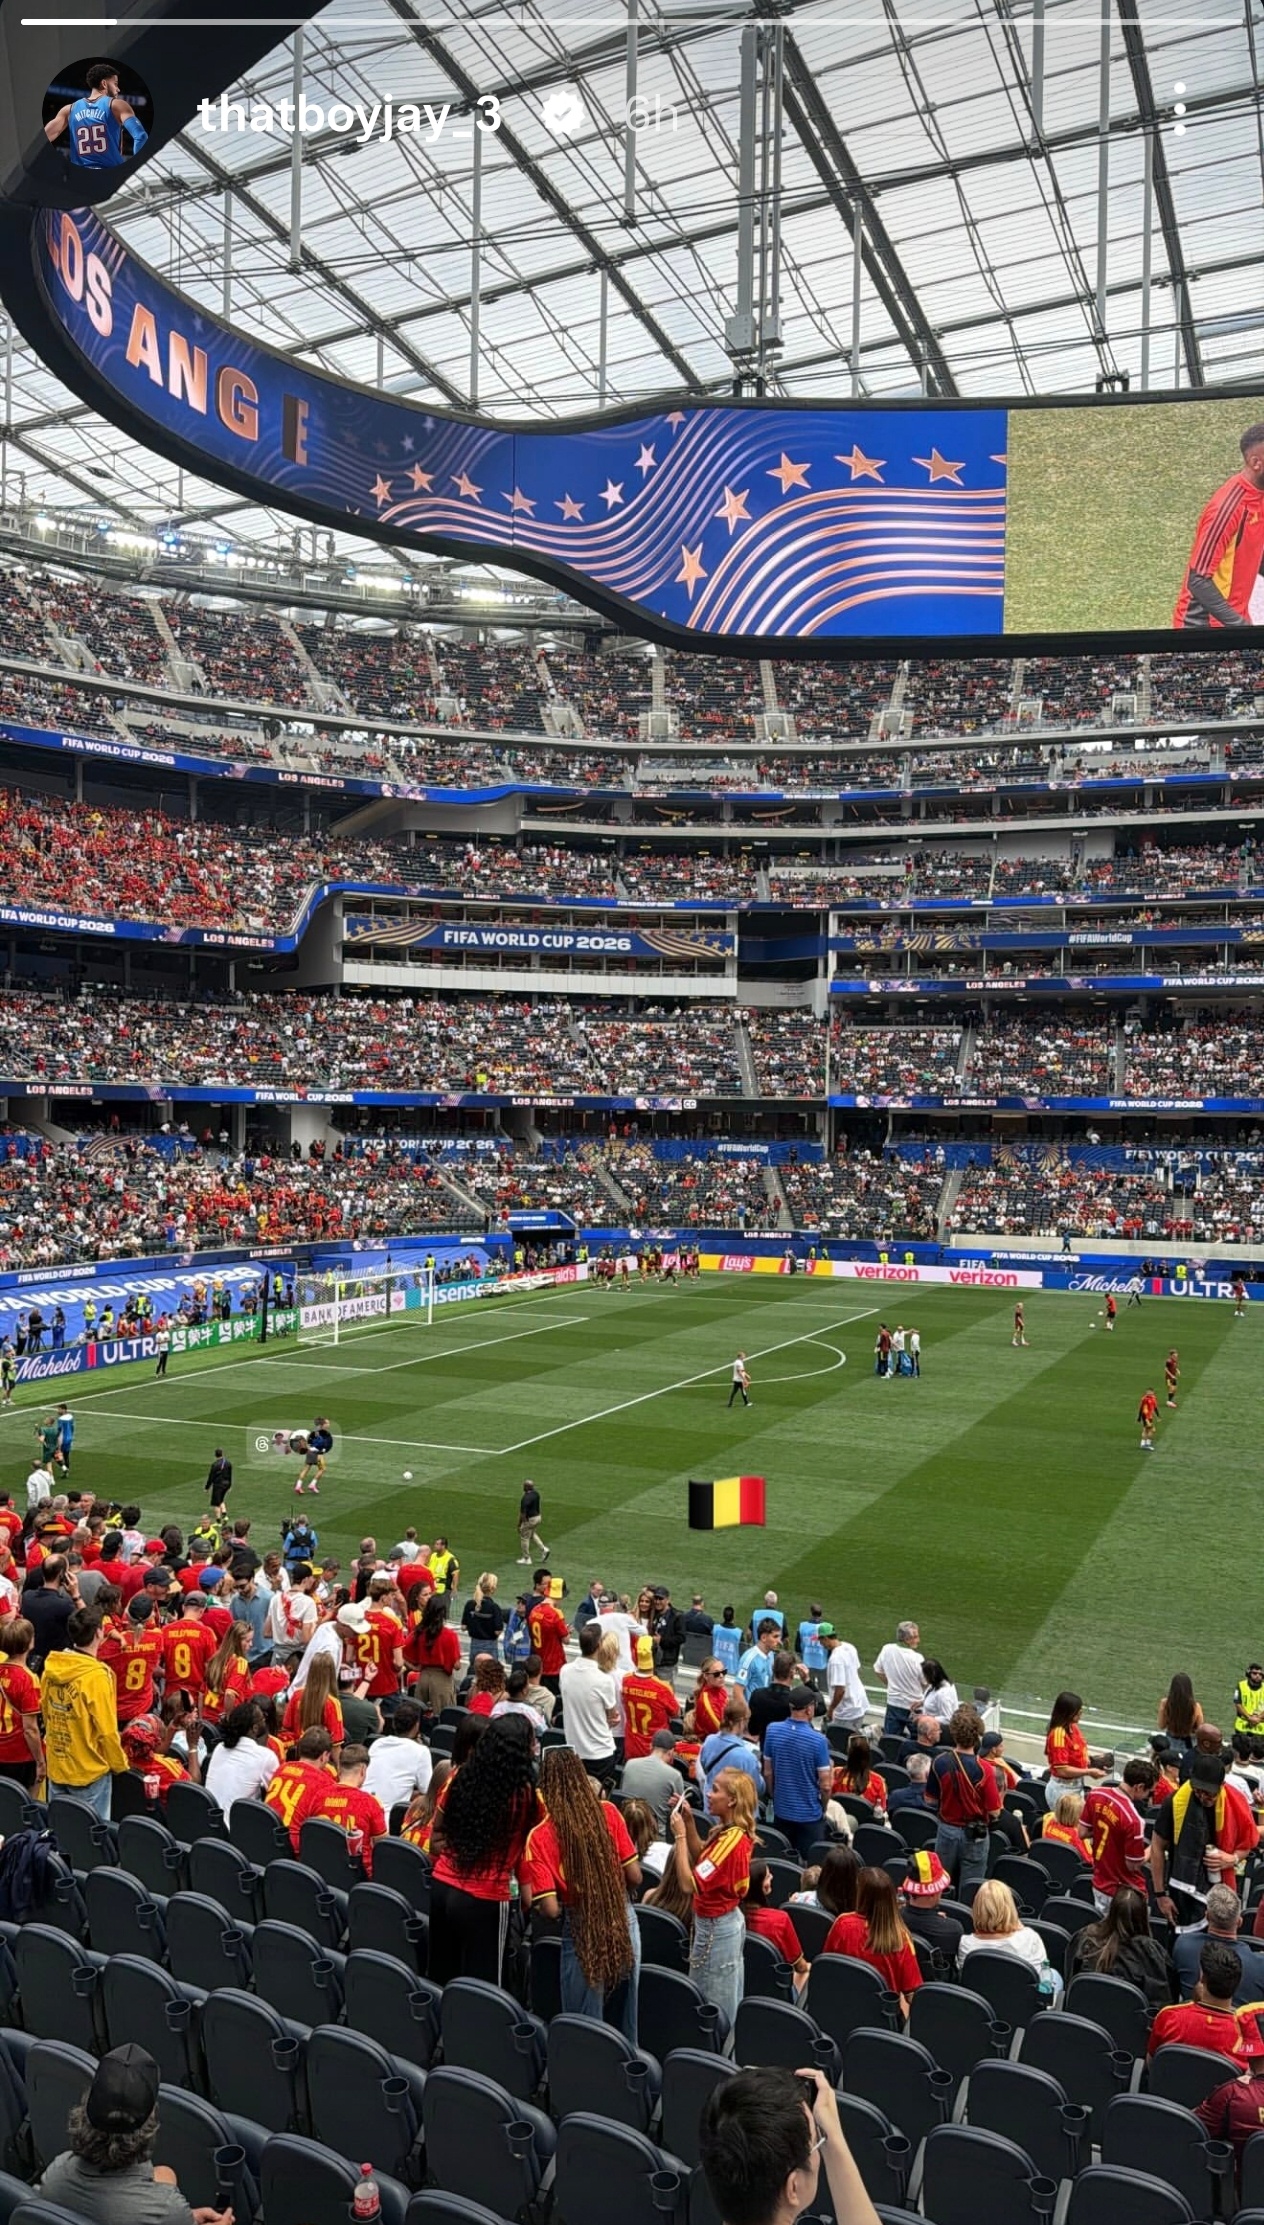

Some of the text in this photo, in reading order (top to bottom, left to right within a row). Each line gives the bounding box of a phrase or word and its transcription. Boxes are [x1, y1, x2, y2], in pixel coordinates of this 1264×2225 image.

[62, 737, 176, 765] FIFA WORLD CUP 2026
[278, 771, 345, 788] LOS ANGELES
[18, 911, 56, 926] WORLD
[57, 915, 78, 929] CUP
[78, 921, 115, 933] 2026
[203, 933, 275, 949] LOS ANGELES
[444, 931, 631, 950] FIFA WORLD CUP 2026
[1068, 932, 1133, 945] #FIFAWorldCup
[985, 981, 1026, 989] ANGELES
[1163, 978, 1183, 986] FIFA
[1217, 977, 1235, 985] CUP
[26, 1085, 93, 1096] LOS ANGELES
[255, 1092, 354, 1102] FIFA WORL CUP 2026
[512, 1097, 574, 1107] LOS ANGELES
[943, 1098, 959, 1106] LOS
[1109, 1100, 1127, 1108] FIFA
[1128, 1100, 1157, 1108] WORLD
[1157, 1100, 1174, 1108] CUP
[723, 1255, 752, 1271] Lay's
[1009, 1253, 1036, 1261] WORLD
[1037, 1253, 1053, 1261] CUP
[18, 1273, 33, 1283] FIFA
[33, 1270, 58, 1281] WORLD
[58, 1269, 72, 1279] CUP
[854, 1264, 919, 1280] verizon
[950, 1267, 1017, 1286] verizon
[20, 1285, 127, 1306] WORLD
[126, 1276, 176, 1294] CUP
[304, 1308, 332, 1323] BANK
[349, 1298, 386, 1314] AMERIC
[15, 1350, 82, 1381] Michelob
[532, 1621, 542, 1648] 9
[358, 1633, 380, 1663] 21
[174, 1643, 191, 1678] 8
[125, 1658, 146, 1690] 8
[627, 1700, 652, 1736] 17
[265, 1777, 306, 1827] 24
[1096, 1820, 1109, 1860] 7
[906, 1873, 949, 1893] BELGIUM
